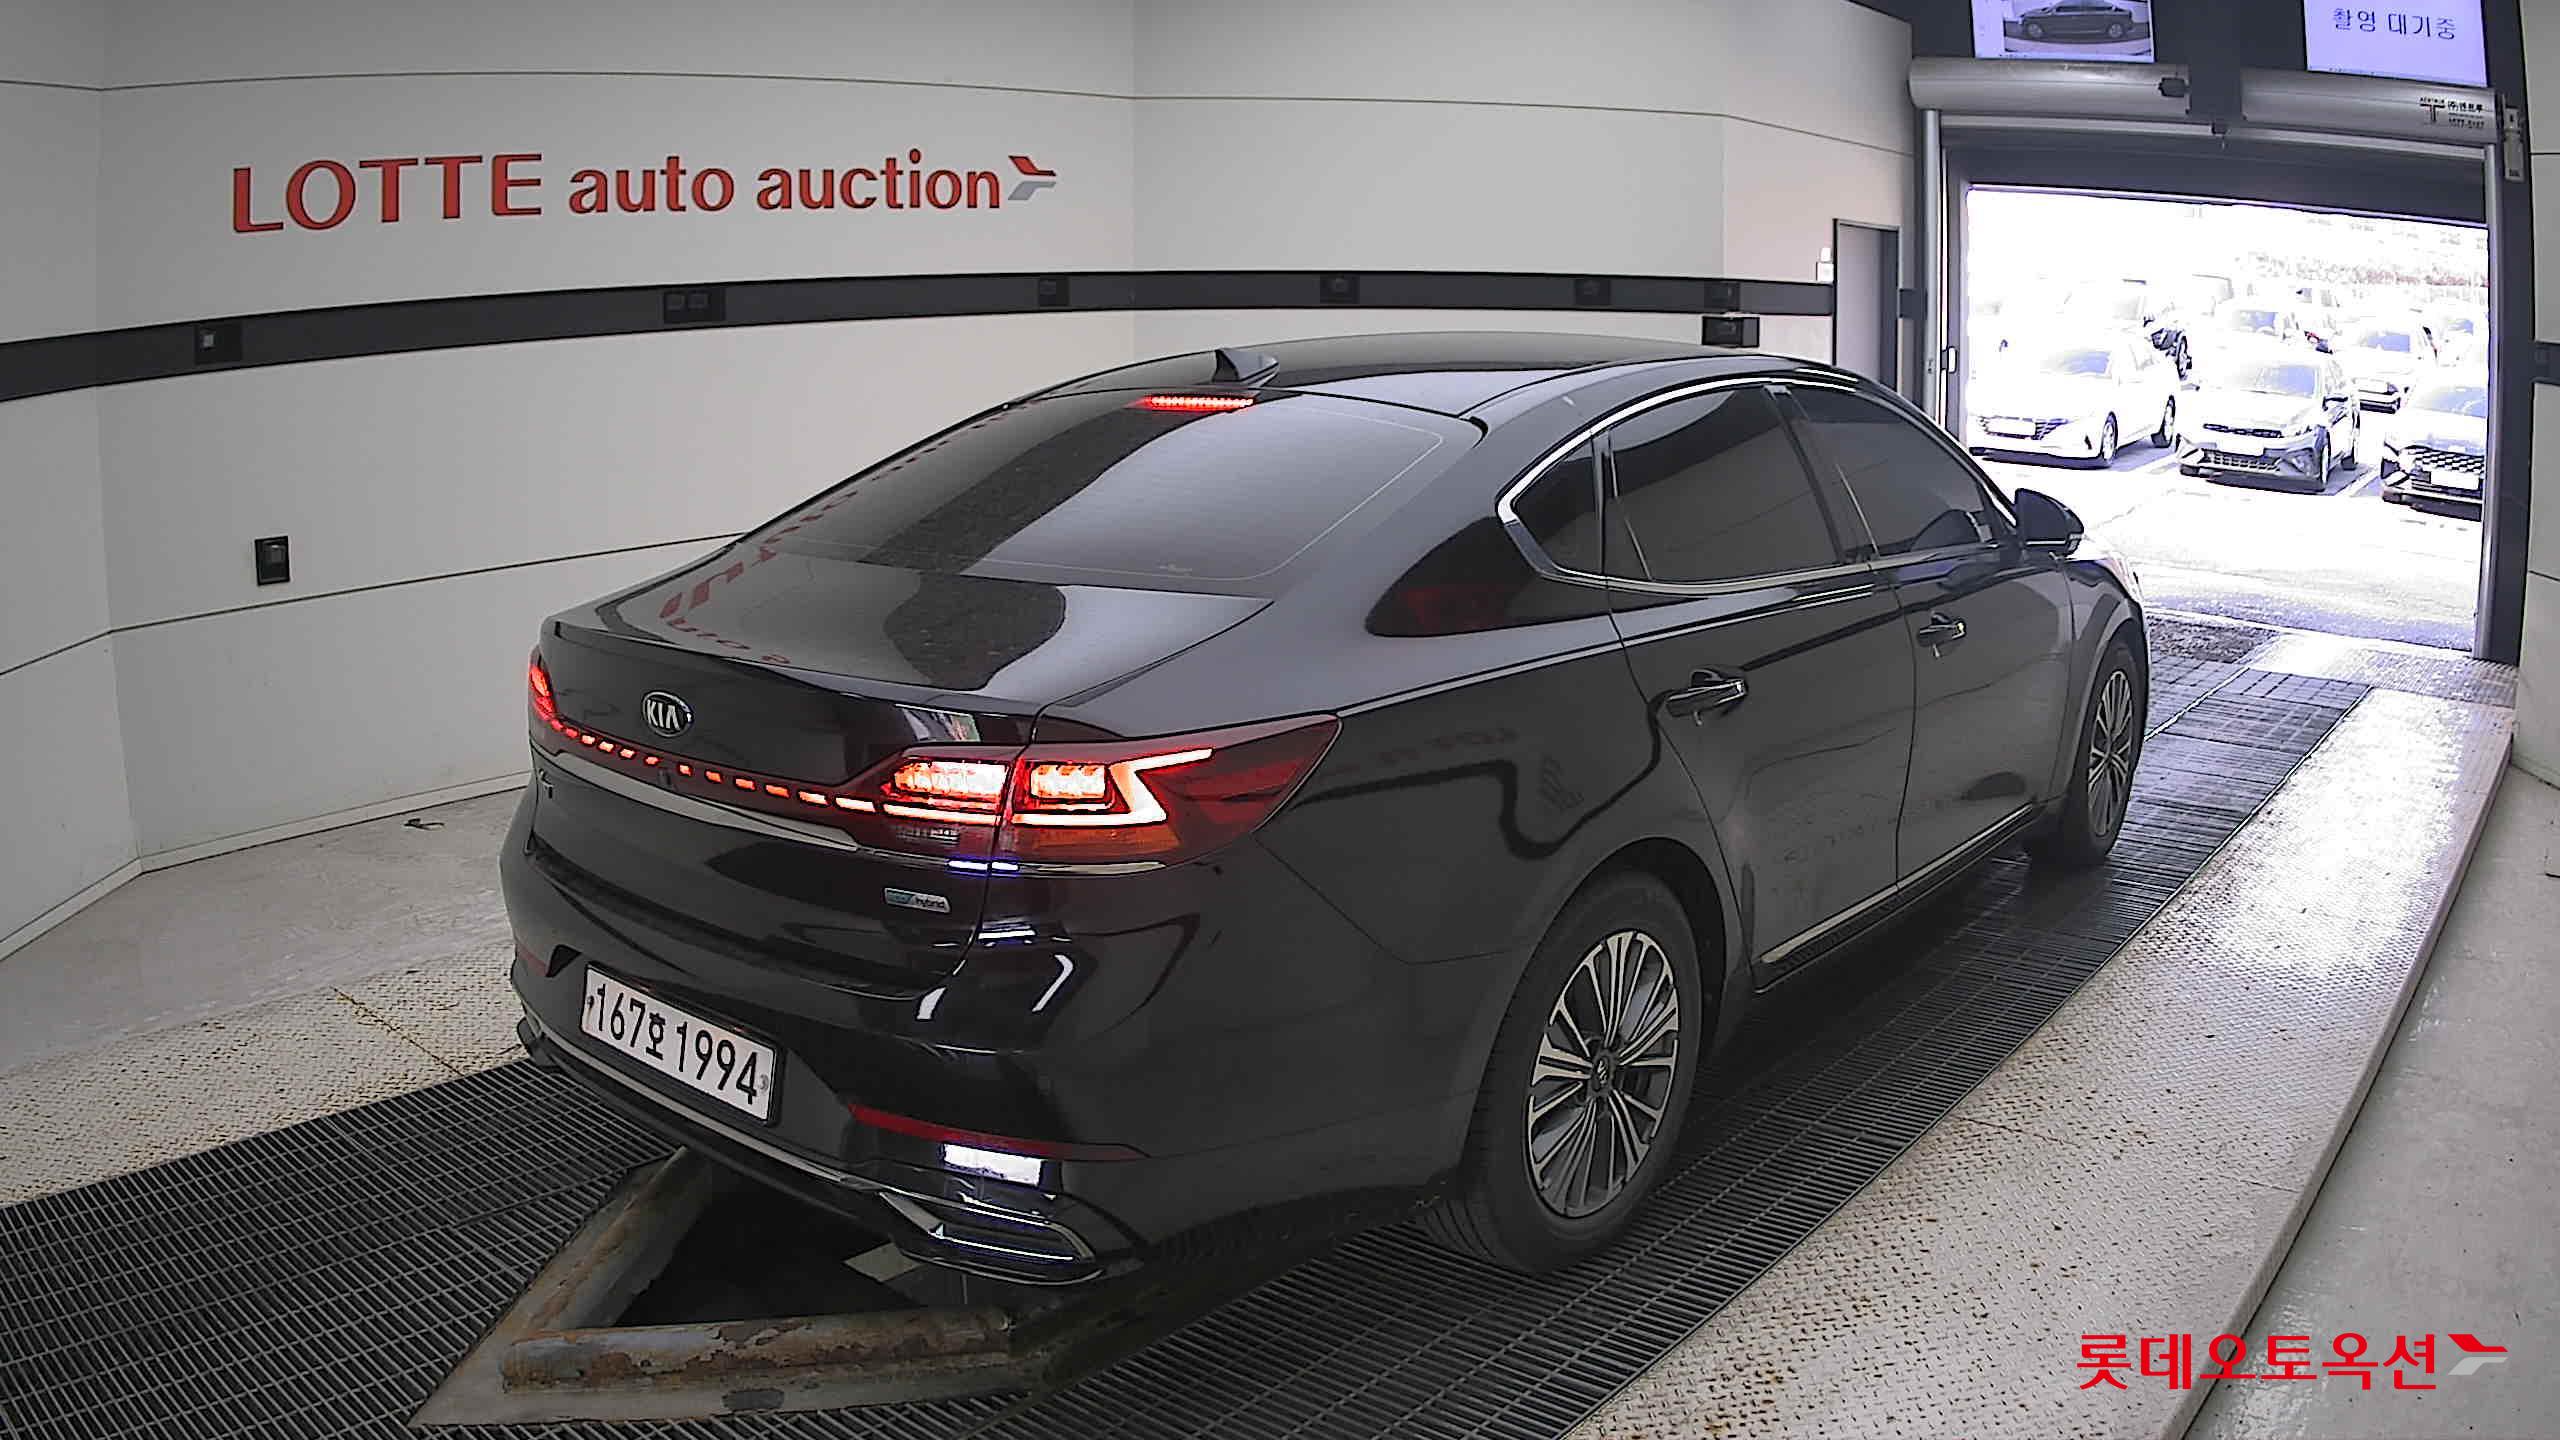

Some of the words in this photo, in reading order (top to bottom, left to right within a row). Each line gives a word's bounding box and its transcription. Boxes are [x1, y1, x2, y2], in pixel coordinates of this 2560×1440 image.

[2388, 13, 2456, 40] 대기중
[233, 153, 541, 232] LOTTE
[569, 157, 735, 213] auto
[757, 149, 1001, 210] auction
[646, 699, 681, 731] KIA
